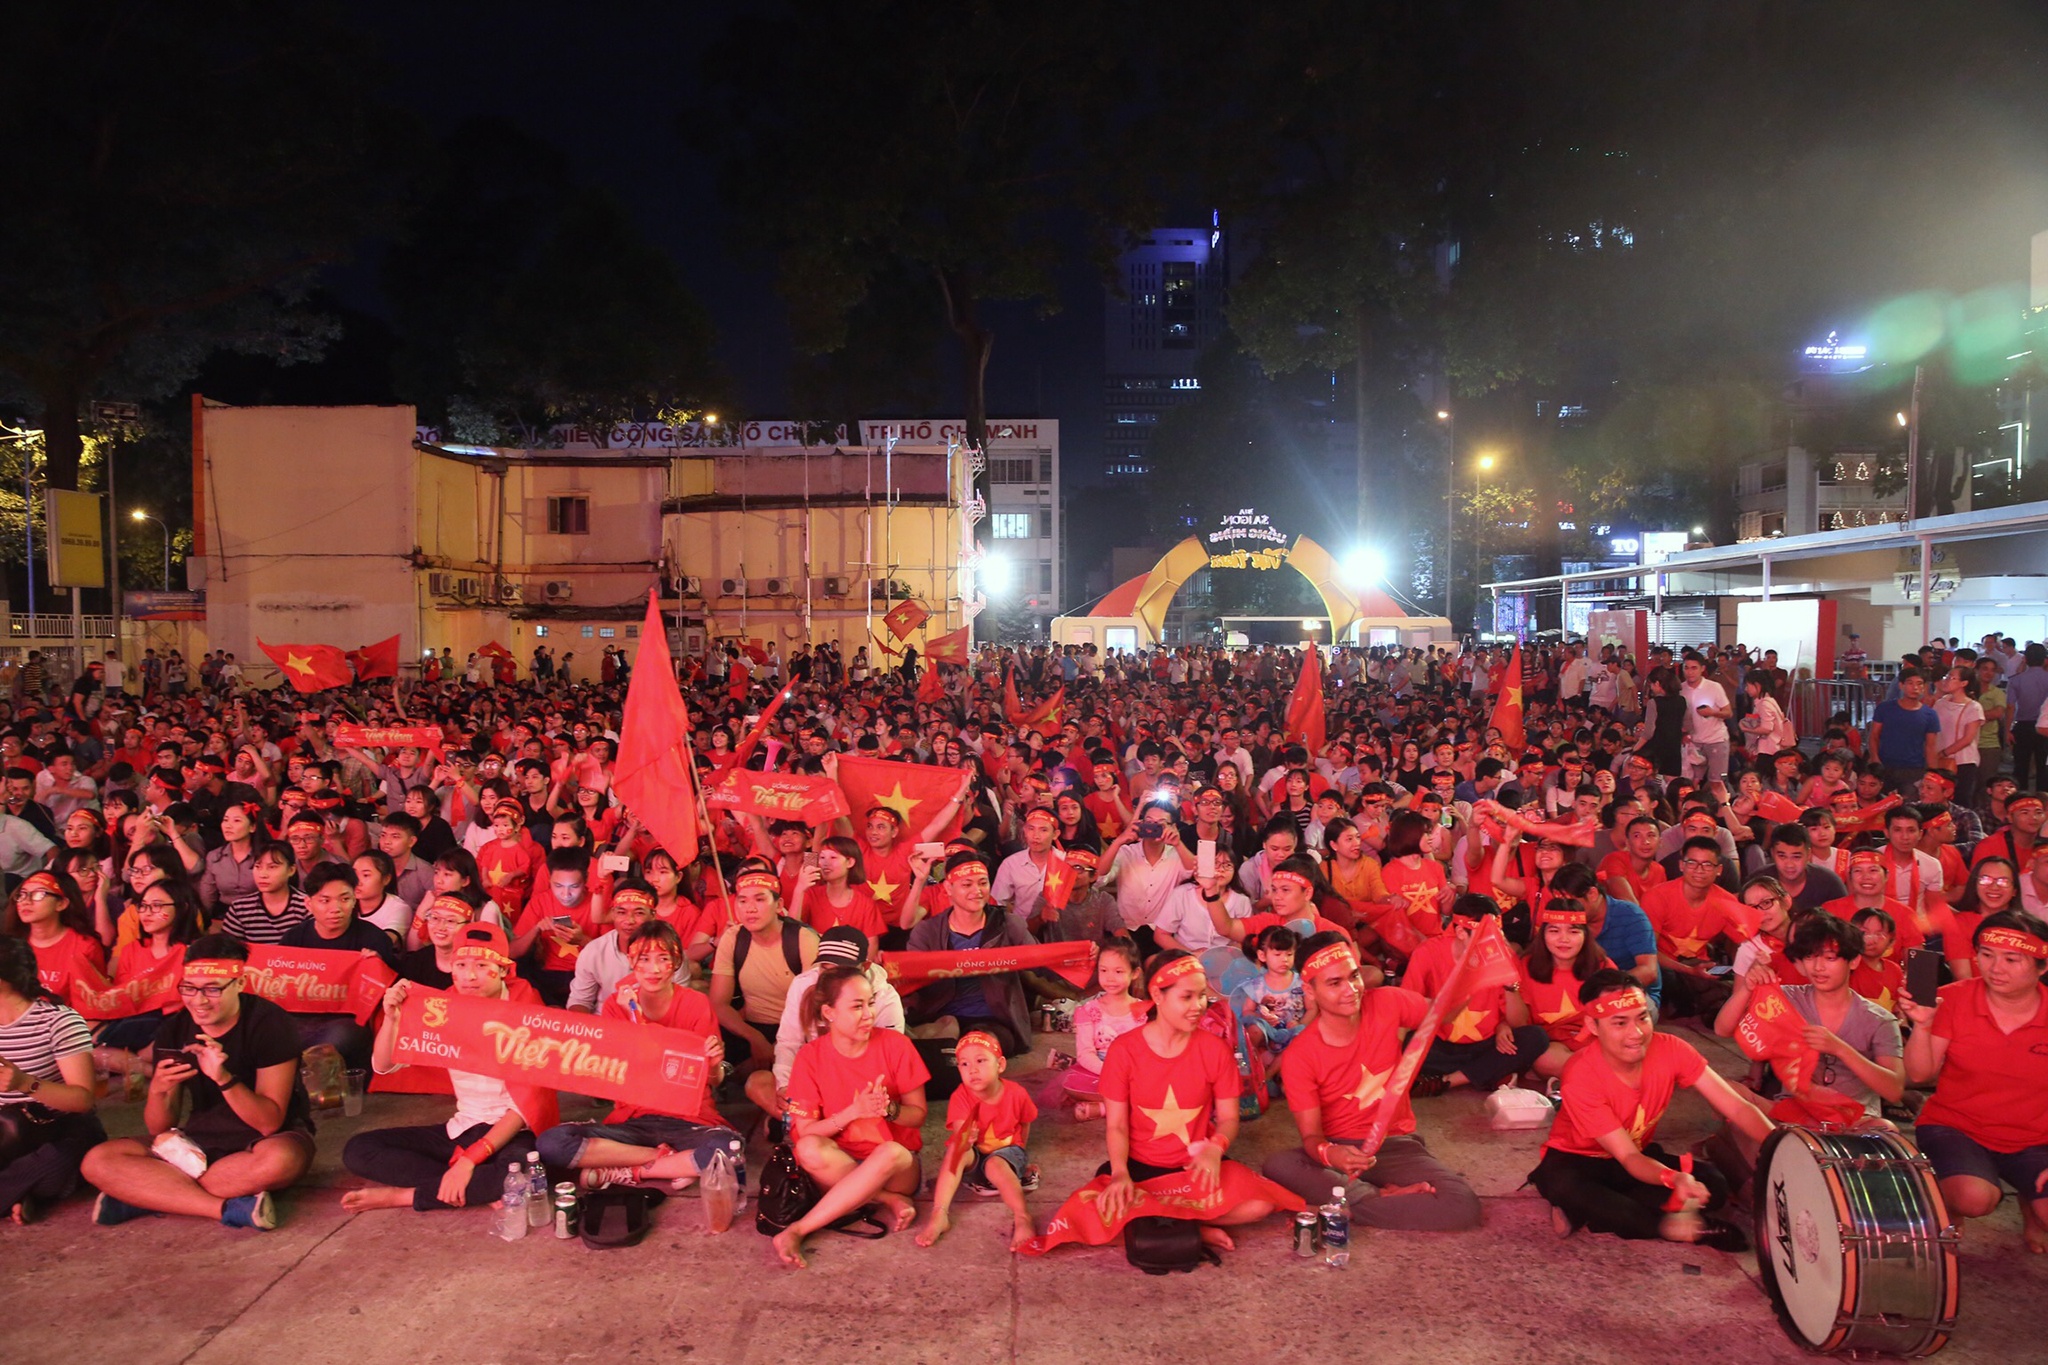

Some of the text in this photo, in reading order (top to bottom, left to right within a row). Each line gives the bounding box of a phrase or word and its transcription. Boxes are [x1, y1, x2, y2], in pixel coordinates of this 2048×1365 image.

[940, 424, 967, 440] CH
[267, 957, 326, 971] UỐNG MỪNG
[75, 979, 127, 1012] Việt
[243, 966, 348, 1001] Việt Nam
[522, 1013, 604, 1039] UỐNG MỪNG
[1744, 1012, 1758, 1029] BIA
[398, 1036, 461, 1059] SAIGON
[422, 1031, 441, 1042] BIA
[1739, 1017, 1767, 1054] IGON
[482, 1020, 629, 1085] Việt Nam
